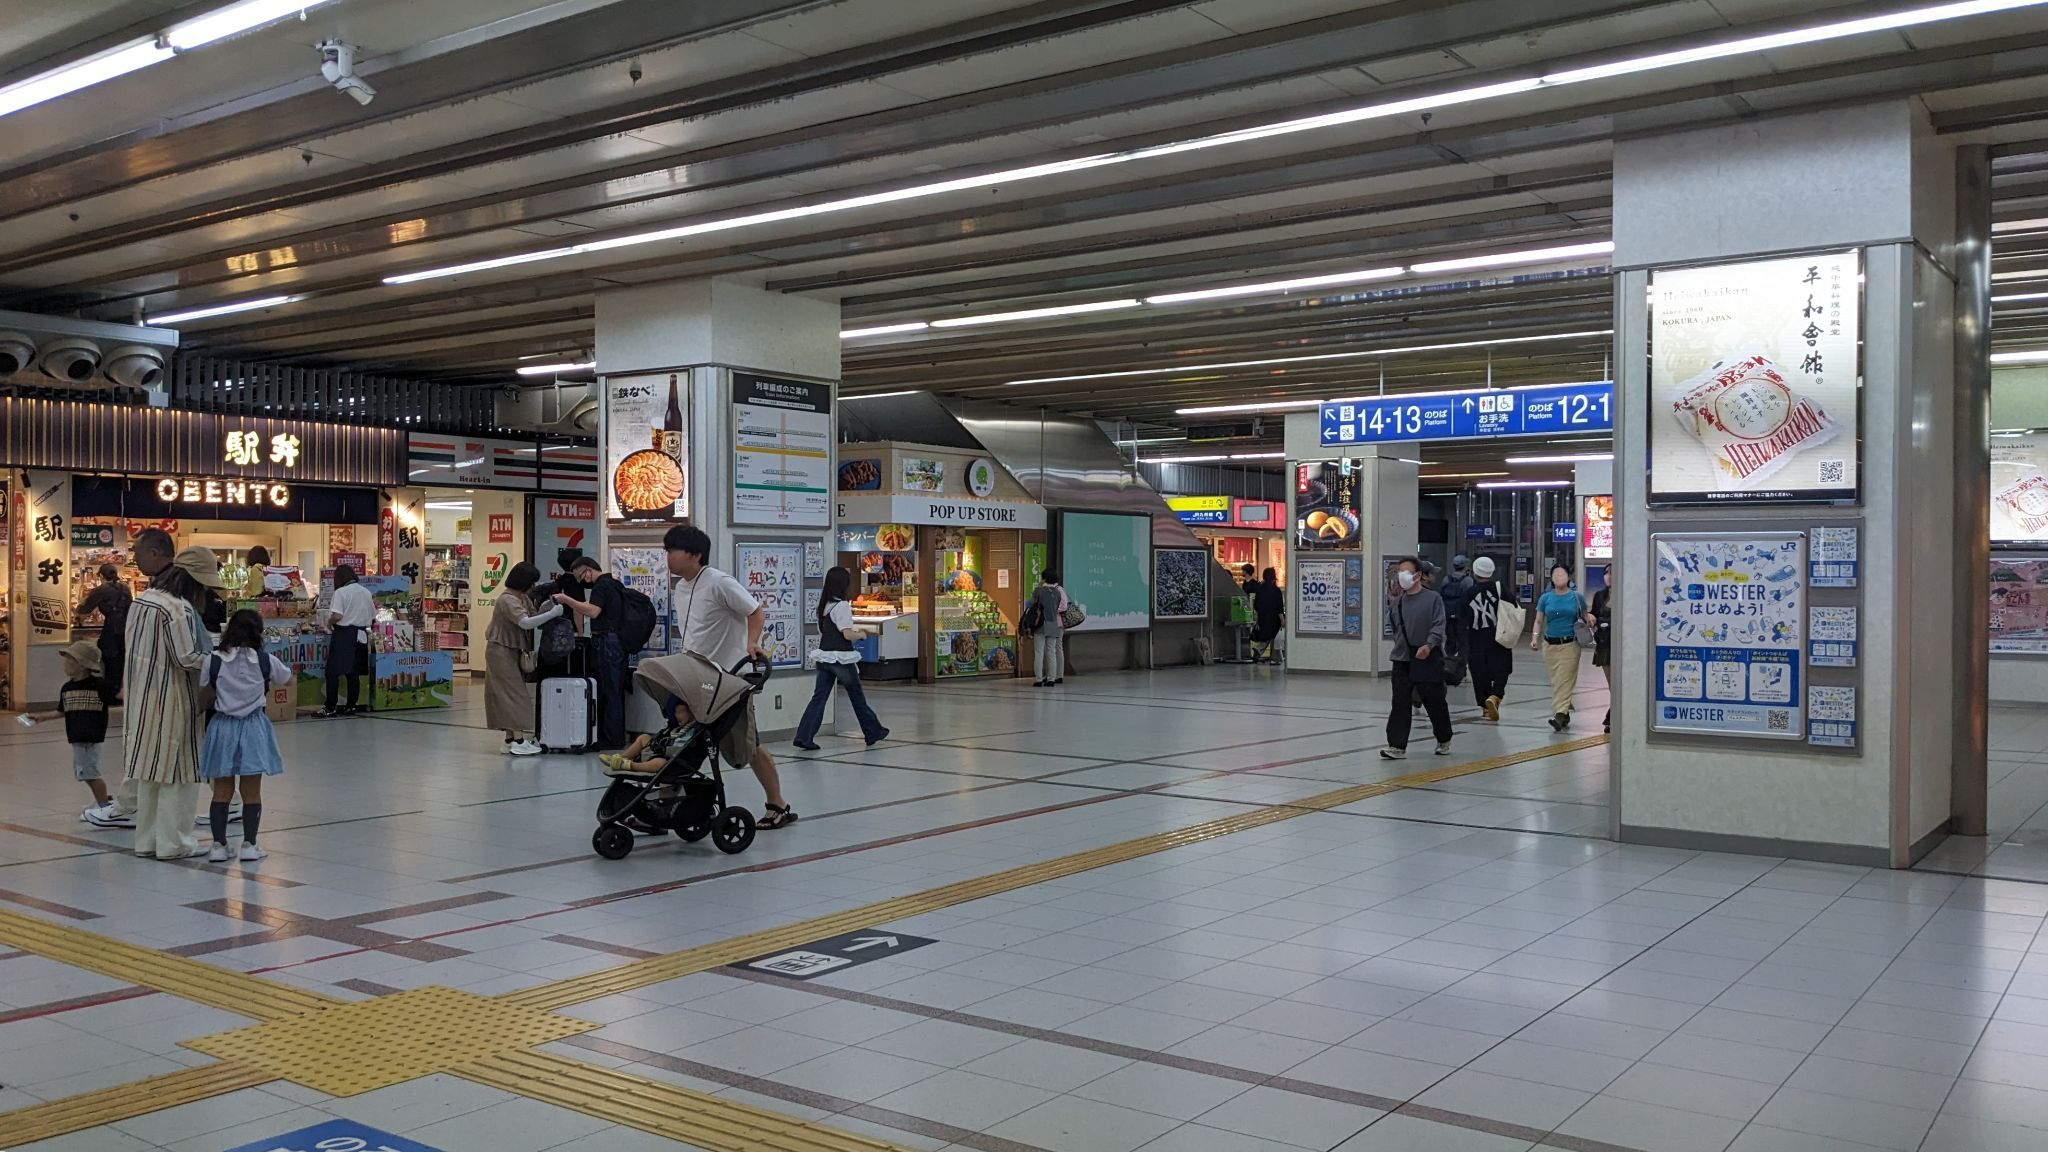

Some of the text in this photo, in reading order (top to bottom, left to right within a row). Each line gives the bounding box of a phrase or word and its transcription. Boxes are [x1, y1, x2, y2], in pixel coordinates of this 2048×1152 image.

[1528, 402, 1554, 412] のりば
[1424, 409, 1448, 419] のりば
[1479, 413, 1509, 424] お手洗
[158, 479, 290, 506] OBENTO
[551, 503, 577, 517] ATM
[929, 504, 1017, 522] POP UP STORE
[492, 518, 512, 531] ATM
[382, 516, 392, 561] お弁当
[838, 531, 875, 543] キンバー
[1555, 527, 1563, 537] 14
[1781, 542, 1796, 550] JR
[632, 576, 655, 586] WESTER
[1302, 582, 1327, 595] 500
[1707, 584, 1766, 600] WESTER
[1690, 602, 1764, 616] はじめよう!
[272, 644, 314, 663] ROLIAN
[1679, 707, 1724, 721] WESTER
